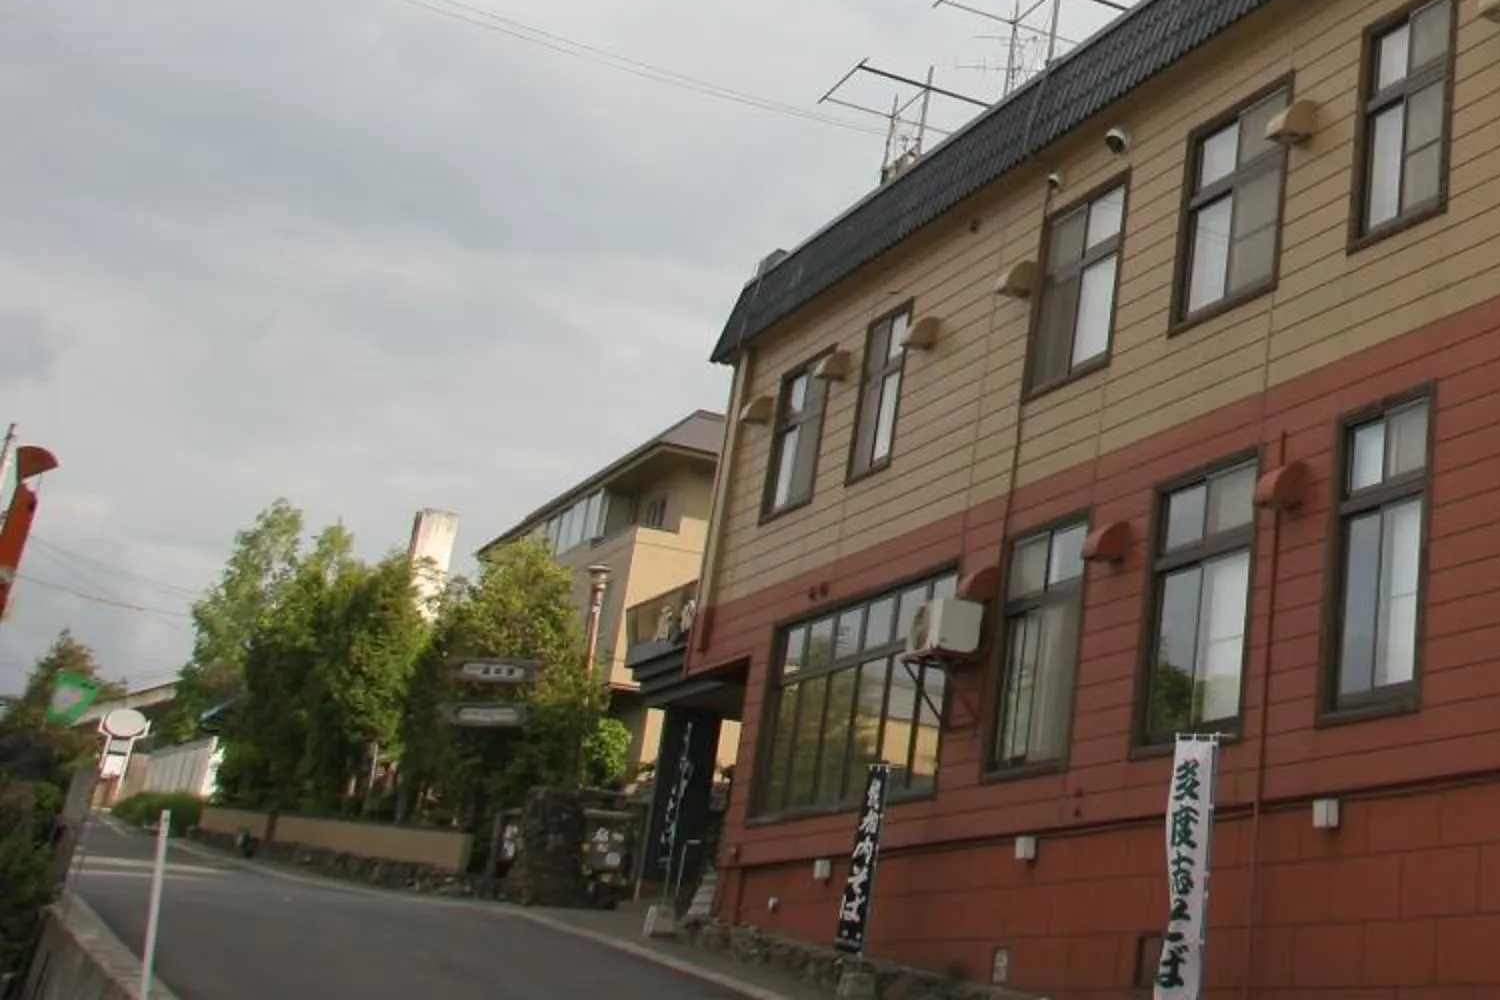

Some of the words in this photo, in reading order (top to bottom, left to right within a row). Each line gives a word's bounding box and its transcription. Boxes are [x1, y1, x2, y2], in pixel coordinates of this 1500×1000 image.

[839, 777, 883, 923] 幌加内そば
